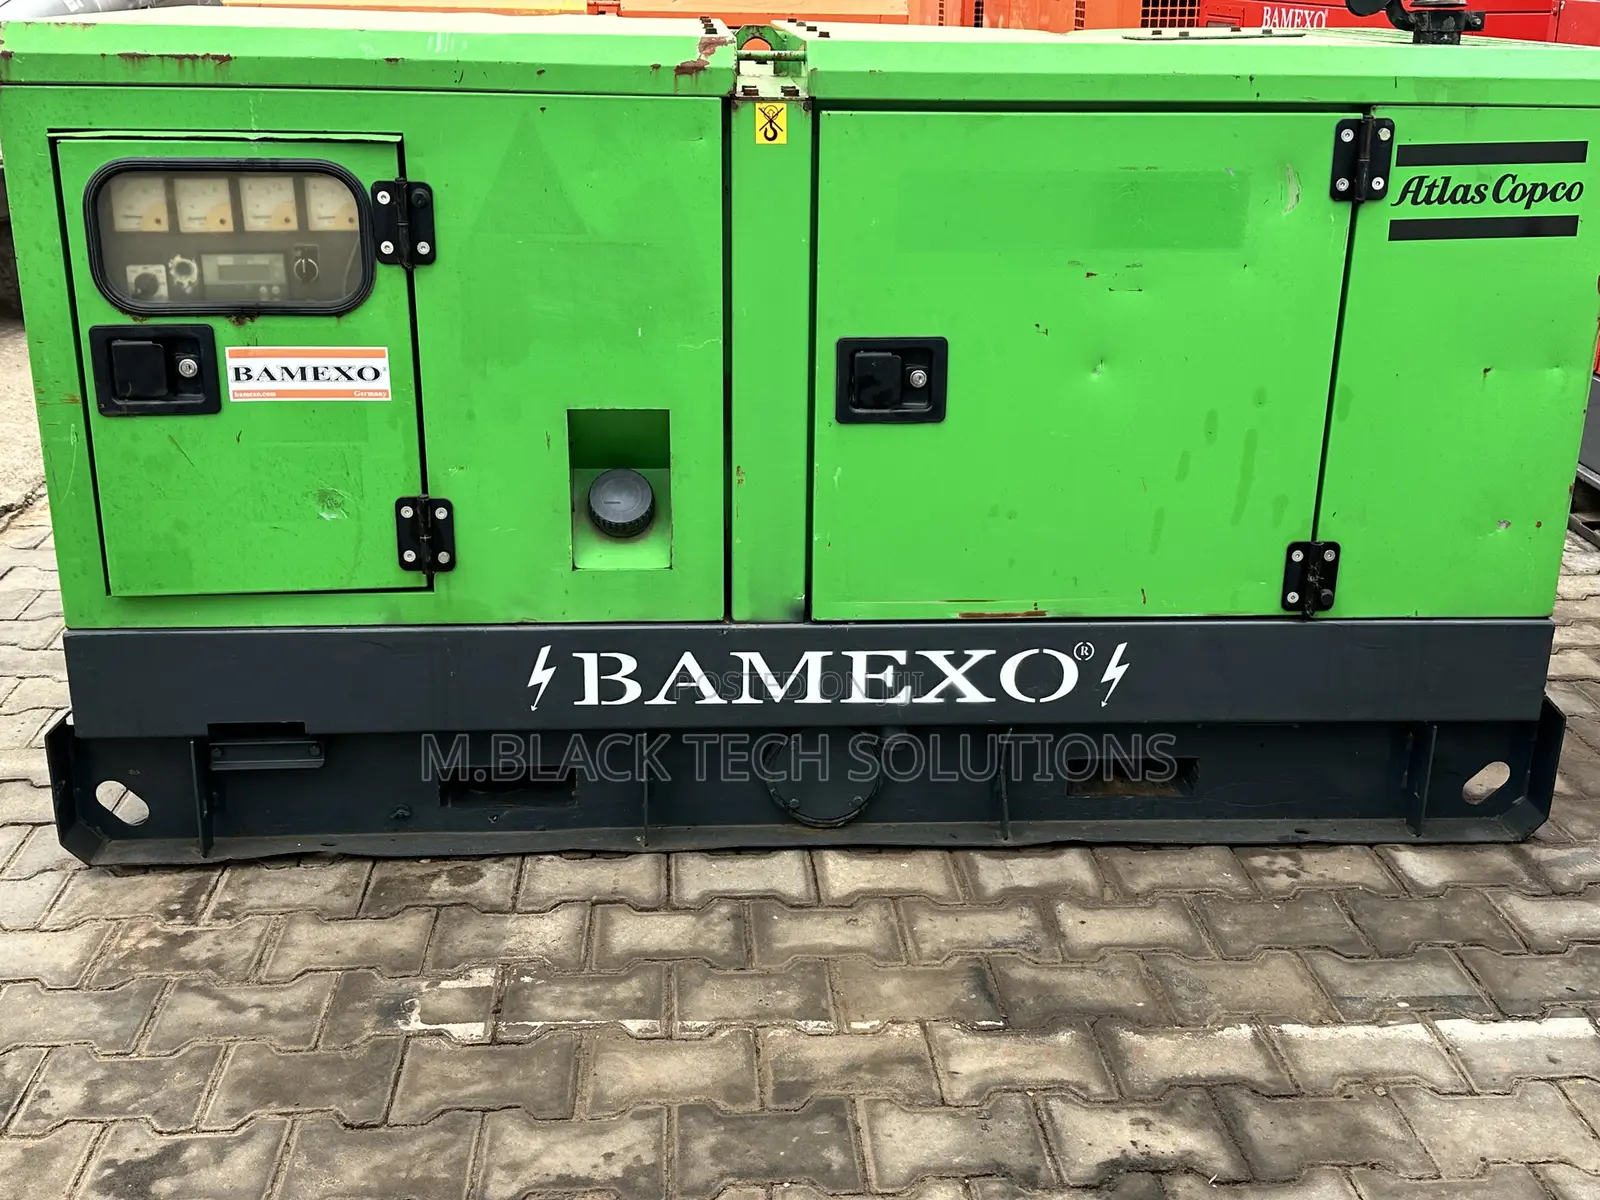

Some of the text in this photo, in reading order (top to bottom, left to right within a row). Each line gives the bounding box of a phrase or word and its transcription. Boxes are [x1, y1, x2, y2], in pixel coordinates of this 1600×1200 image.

[1262, 6, 1327, 28] BAMEXO
[1390, 173, 1584, 210] Atlas Copco
[353, 390, 387, 398] Germany
